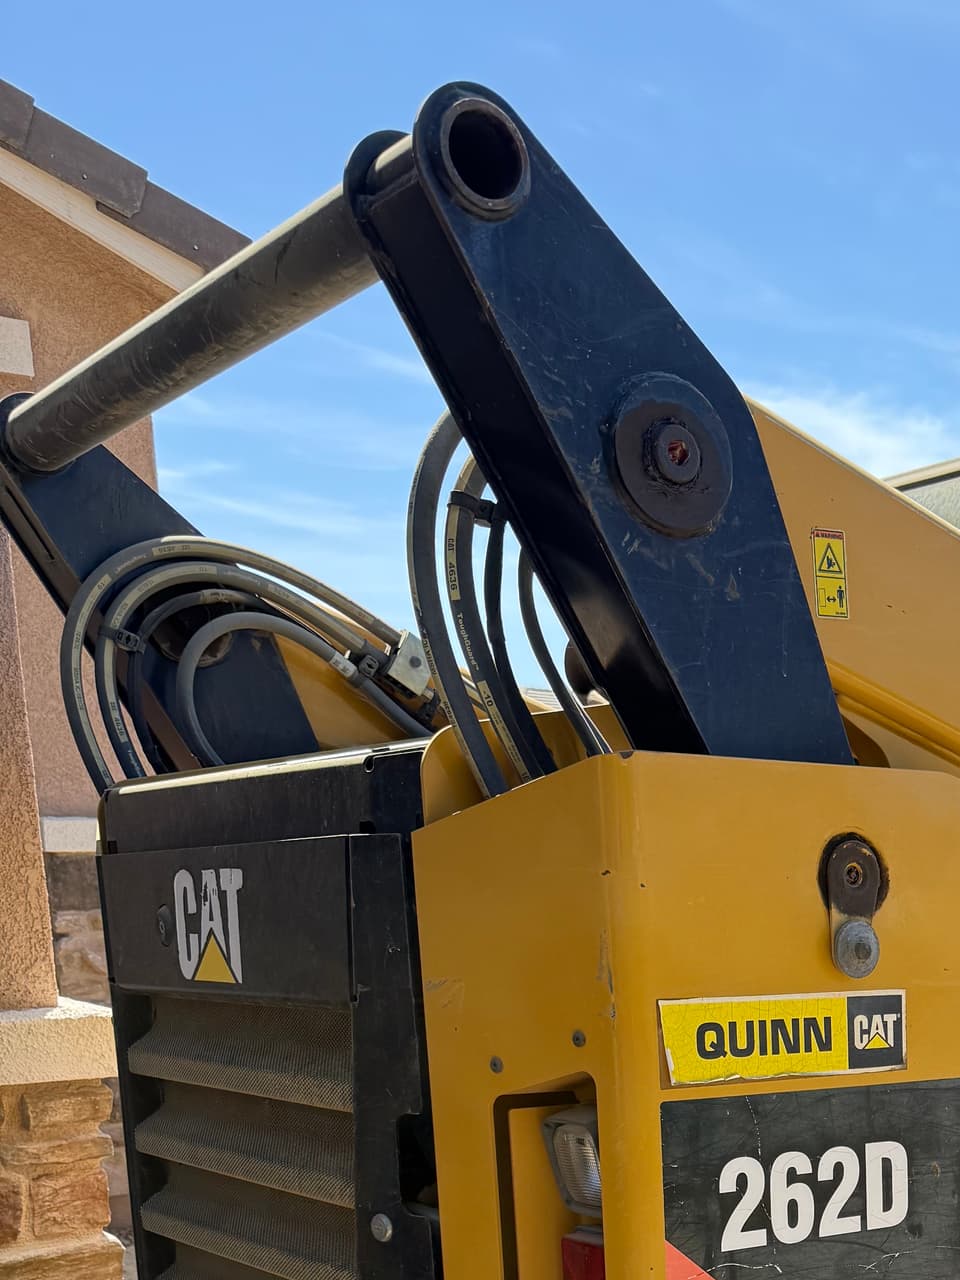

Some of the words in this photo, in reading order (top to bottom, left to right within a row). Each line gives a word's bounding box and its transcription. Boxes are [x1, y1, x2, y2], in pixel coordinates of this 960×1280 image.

[449, 562, 459, 591] 4636
[173, 868, 244, 984] CAT
[696, 1016, 833, 1060] QUINN
[853, 1013, 899, 1051] CAT
[719, 1141, 909, 1253] 262D
